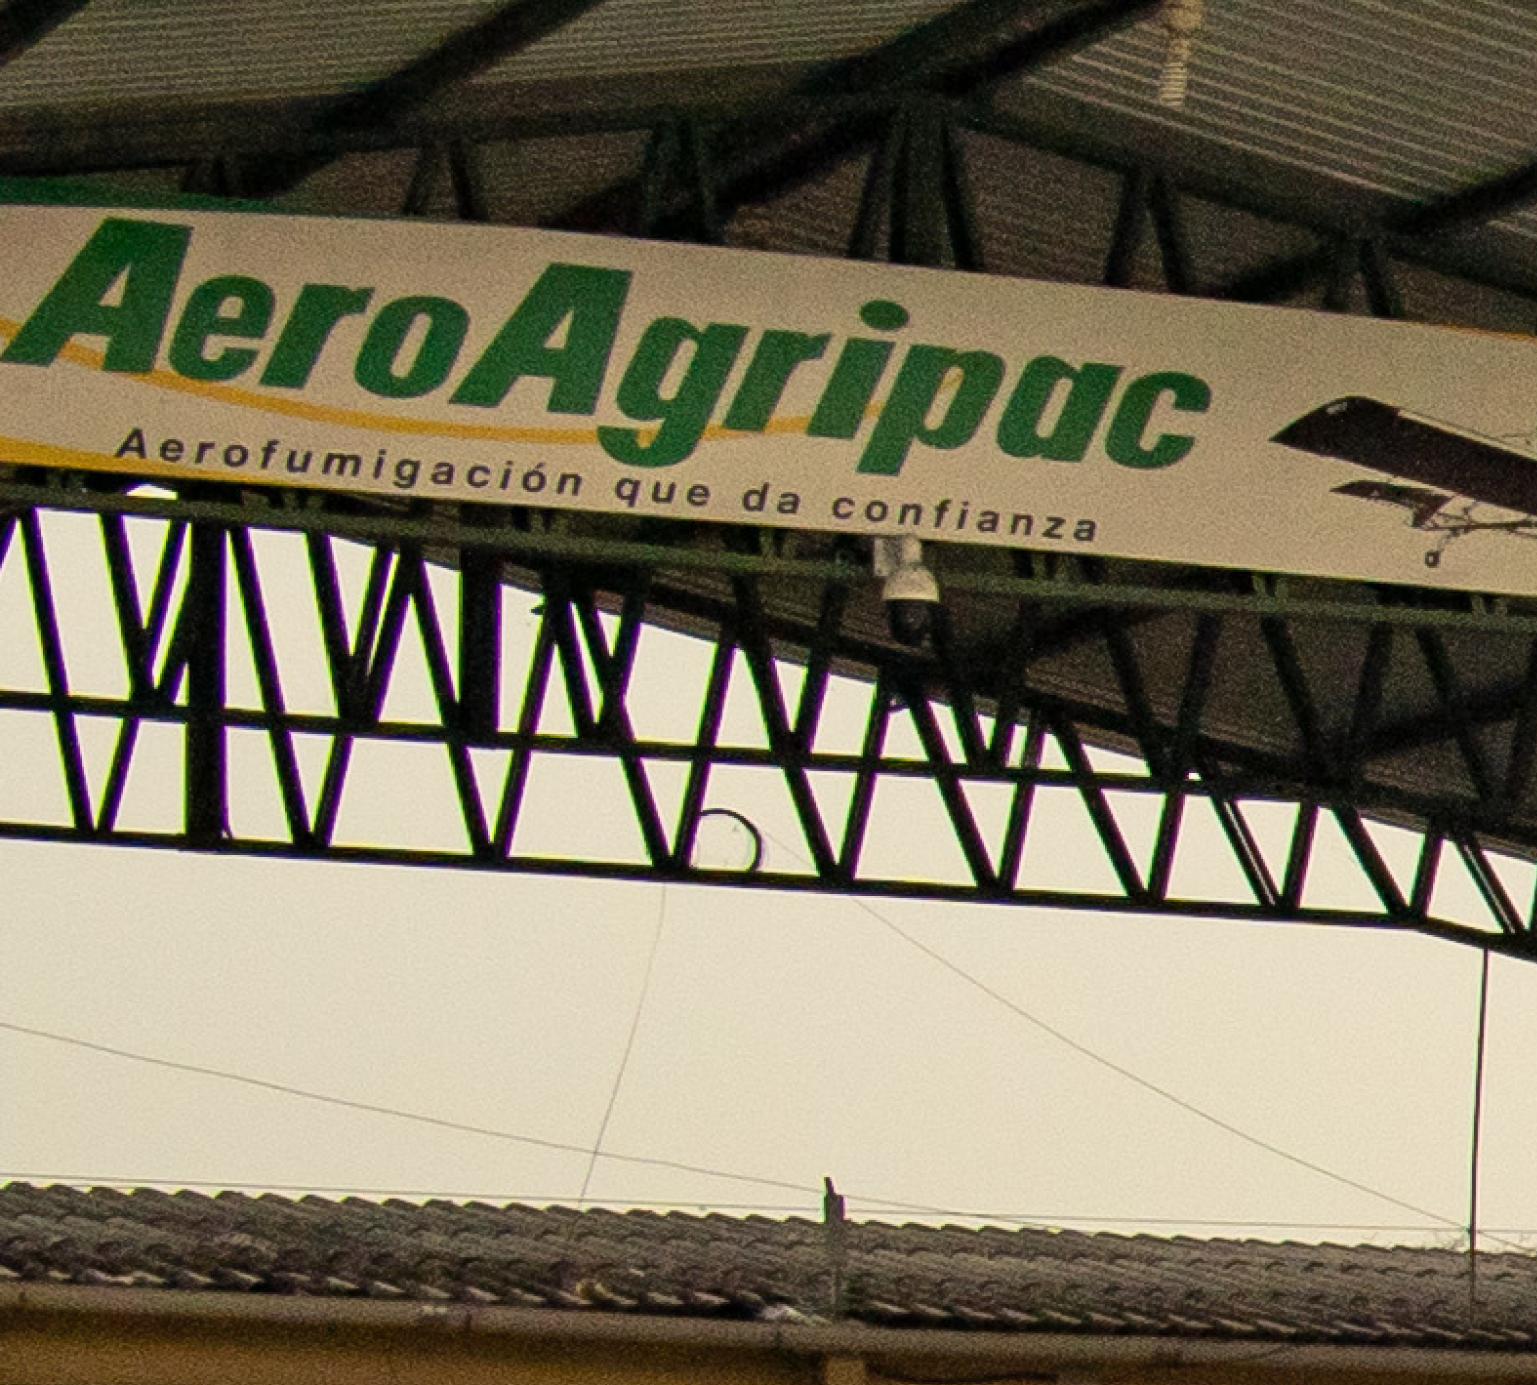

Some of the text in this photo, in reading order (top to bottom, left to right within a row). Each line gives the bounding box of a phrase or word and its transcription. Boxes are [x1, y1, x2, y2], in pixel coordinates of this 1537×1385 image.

[0, 217, 1211, 476] AeroAgripac
[115, 427, 1098, 544] Aerofumigación que da confianza
